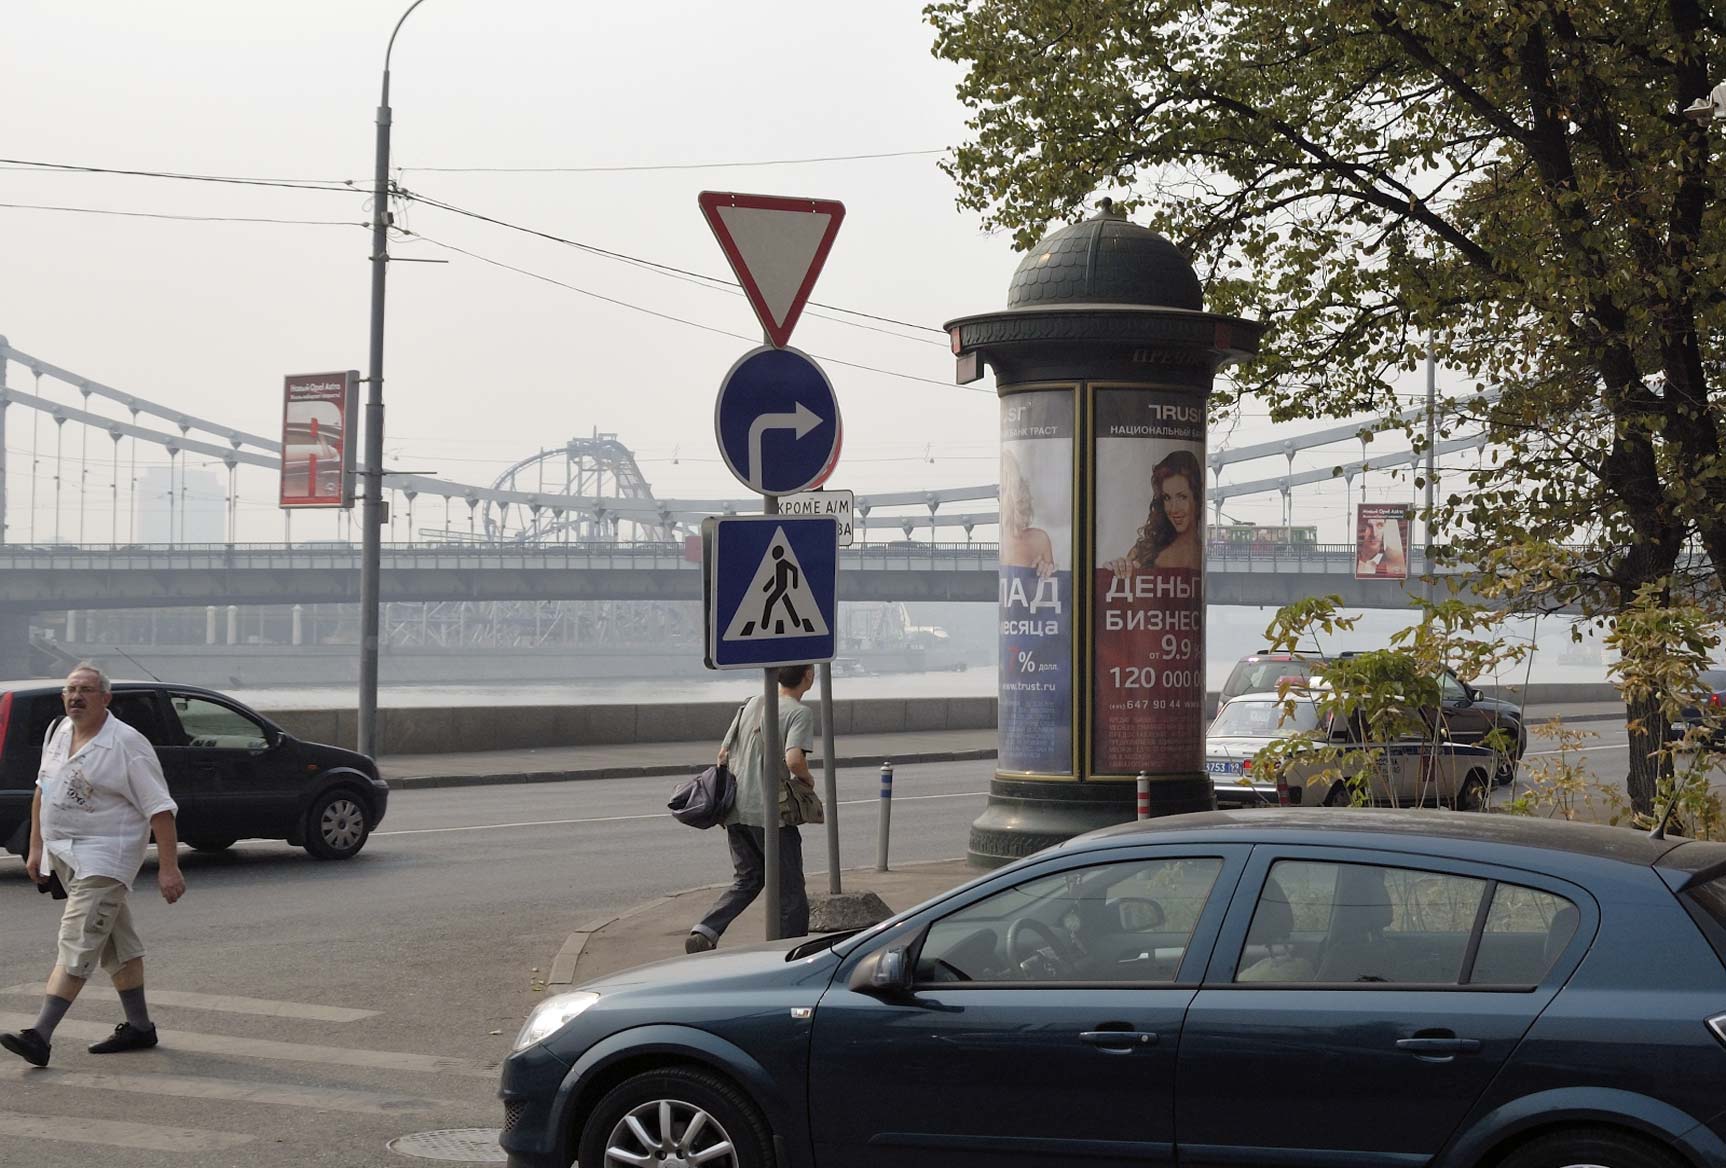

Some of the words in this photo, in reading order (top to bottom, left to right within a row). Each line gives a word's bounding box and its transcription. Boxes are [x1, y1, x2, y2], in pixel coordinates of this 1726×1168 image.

[1029, 425, 1058, 437] ТРАСТ
[1109, 425, 1191, 438] НАЦИОНАЛЬНЫЙ
[778, 501, 821, 514] КРОМЕ
[825, 499, 849, 514] А/М
[1106, 609, 1200, 631] БИЗНЕС
[1149, 652, 1160, 660] от
[1109, 666, 1156, 689] 120
[1162, 670, 1191, 688] 000
[1126, 700, 1149, 710] 647
[1152, 699, 1166, 710] 90
[1169, 699, 1181, 709] 44
